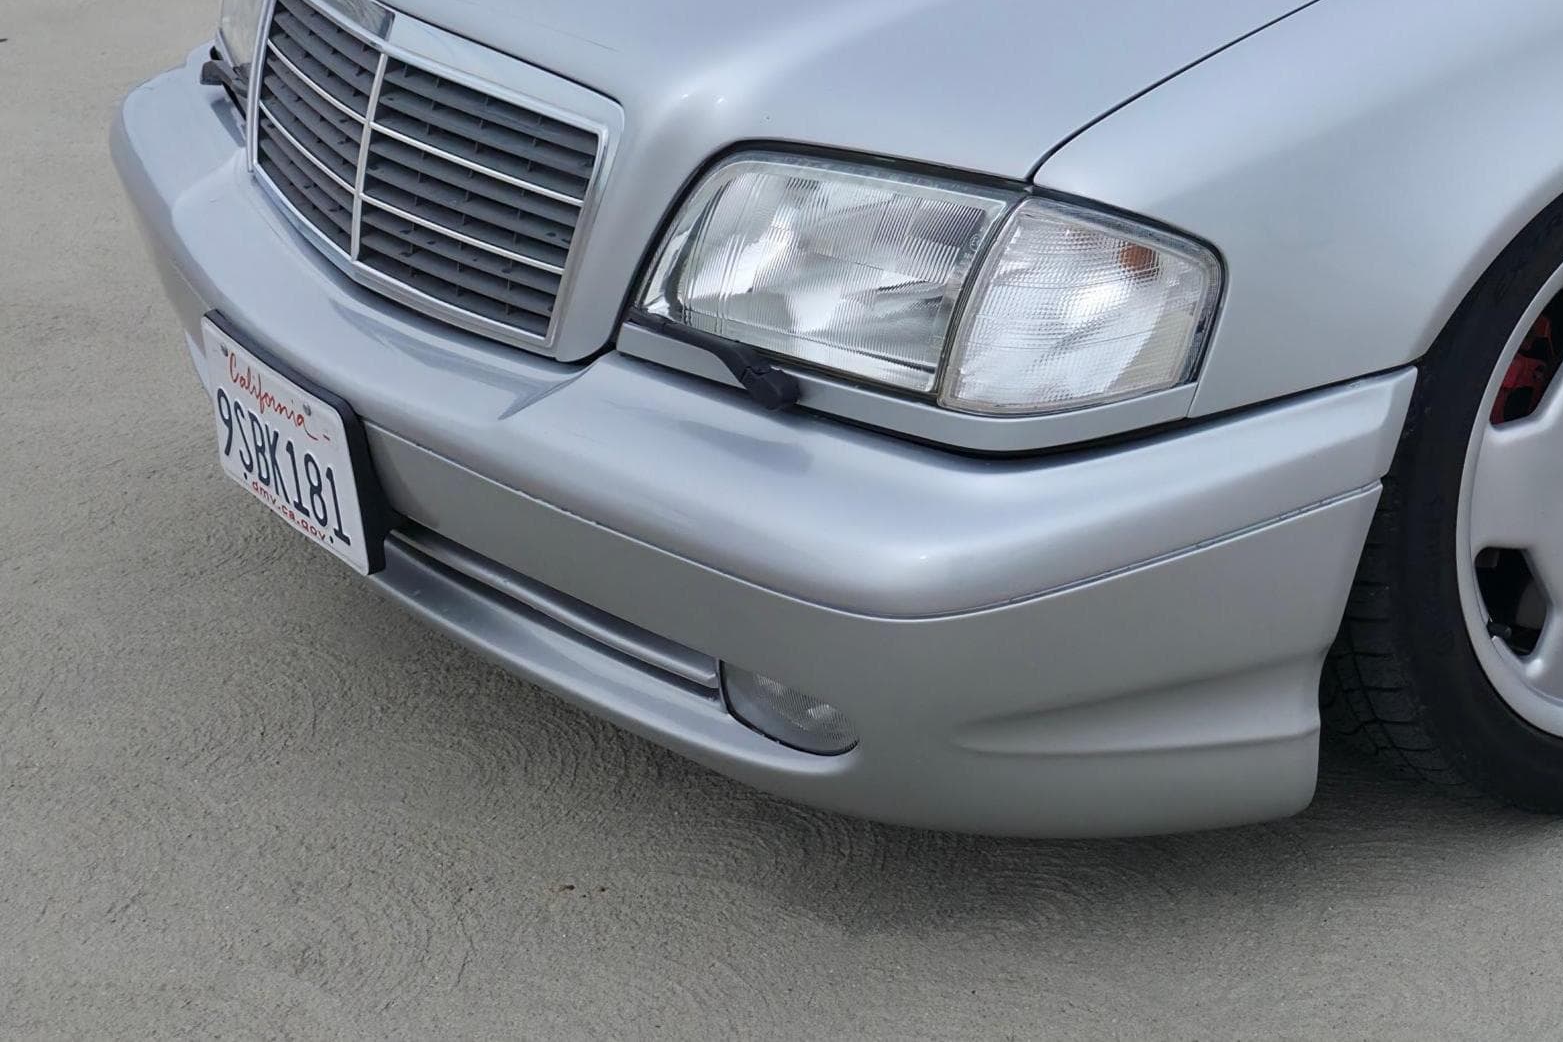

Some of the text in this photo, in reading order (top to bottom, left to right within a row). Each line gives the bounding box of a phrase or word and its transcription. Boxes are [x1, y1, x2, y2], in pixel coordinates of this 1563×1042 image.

[229, 352, 318, 440] California
[218, 389, 351, 547] 9SBK181
[251, 480, 327, 543] dmv.ca.gov
